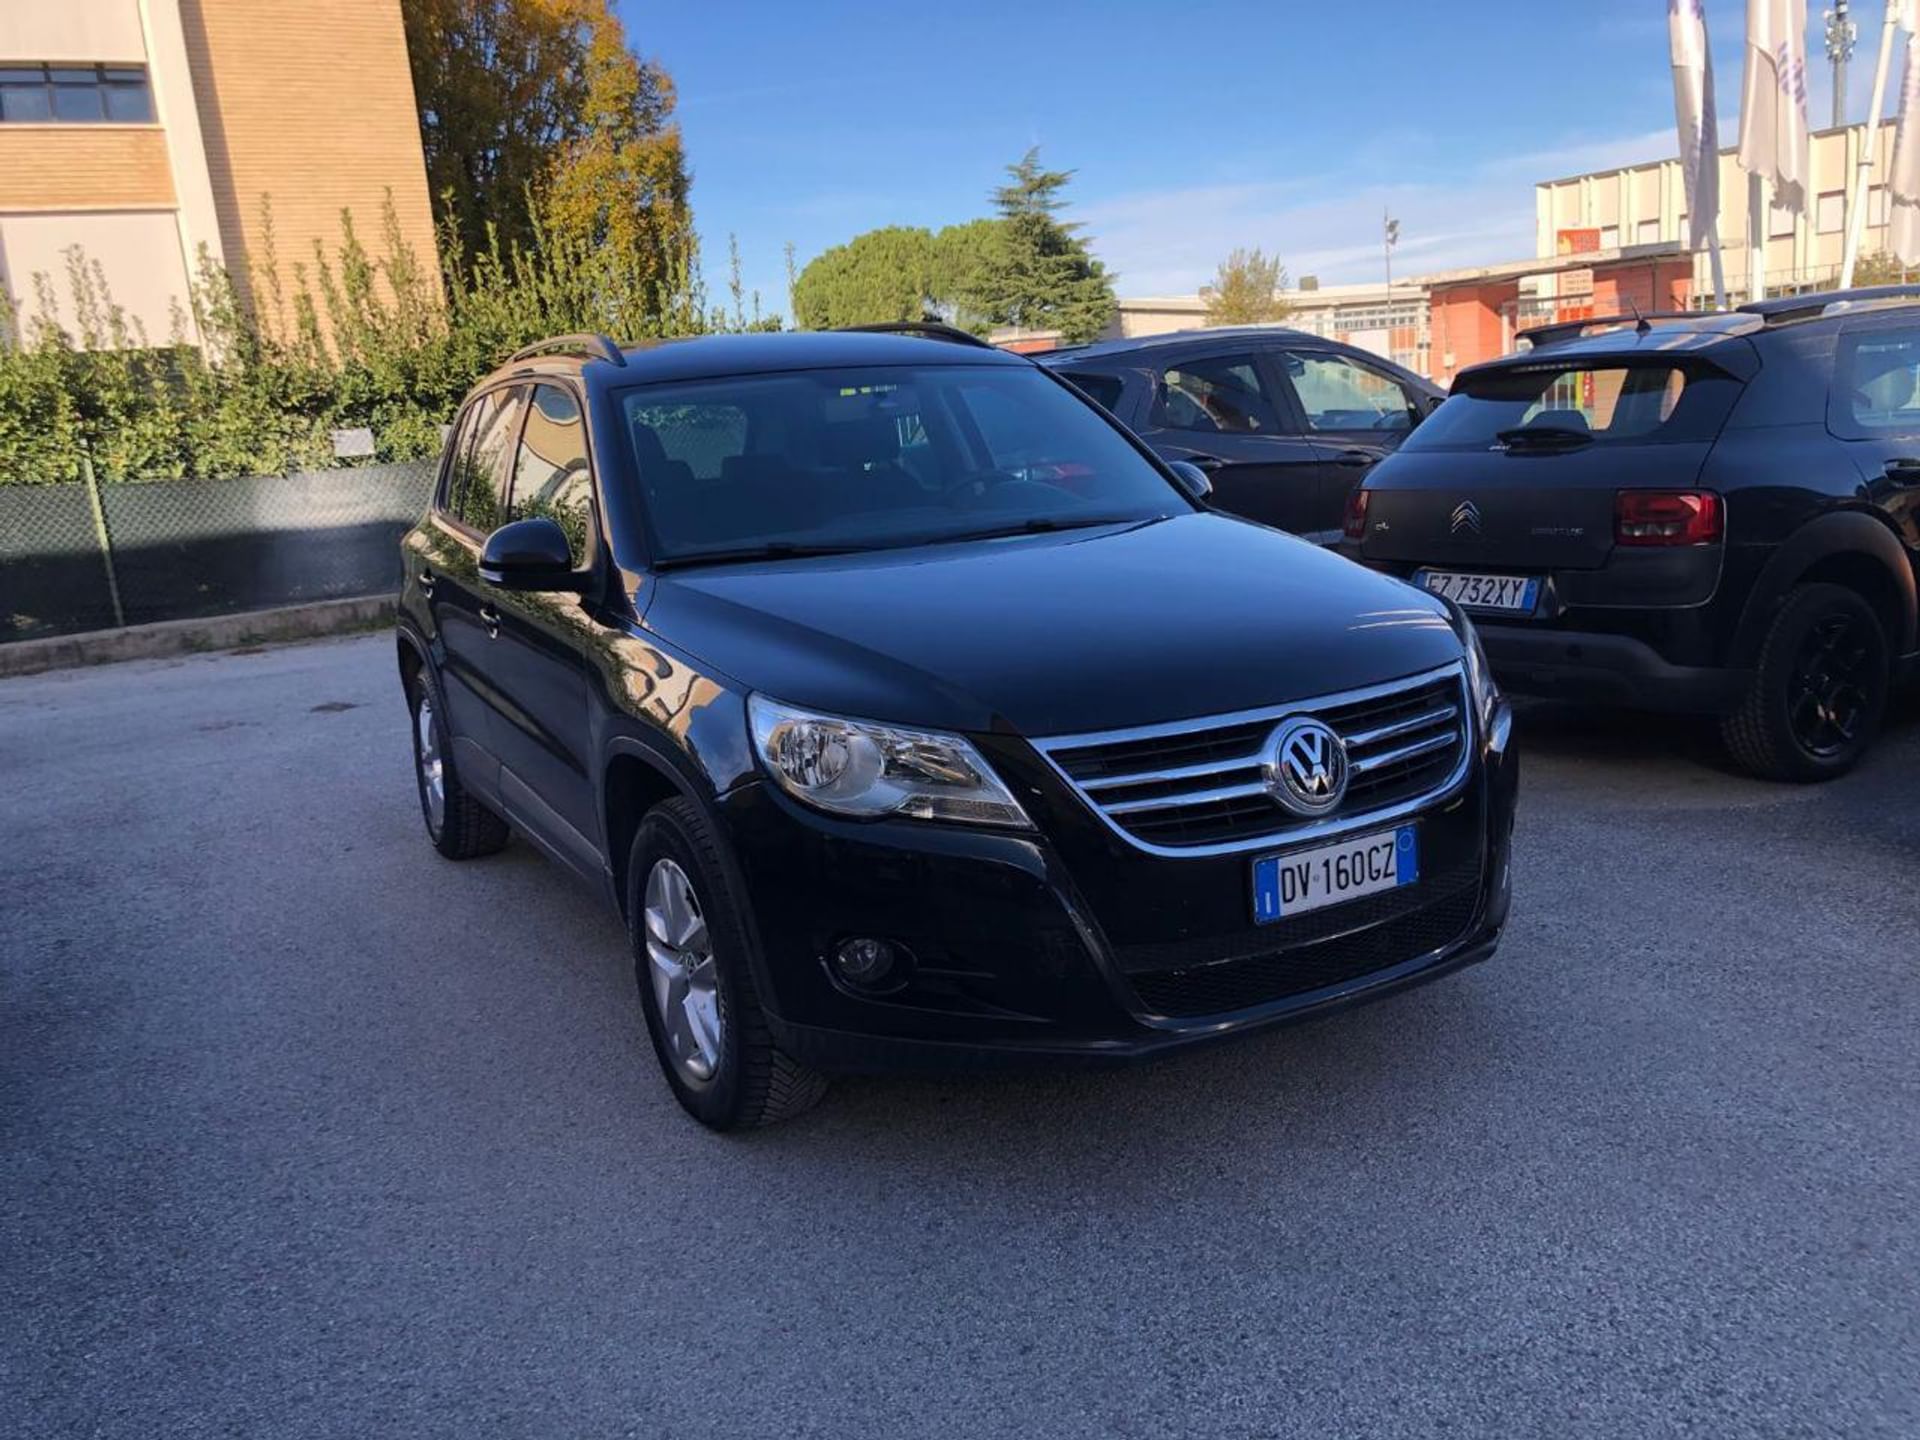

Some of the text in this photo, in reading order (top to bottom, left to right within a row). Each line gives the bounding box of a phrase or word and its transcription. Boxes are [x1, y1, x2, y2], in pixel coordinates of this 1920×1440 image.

[1455, 576, 1524, 606] 732XY
[1281, 861, 1311, 904] DV
[1322, 840, 1396, 895] 160GZ
